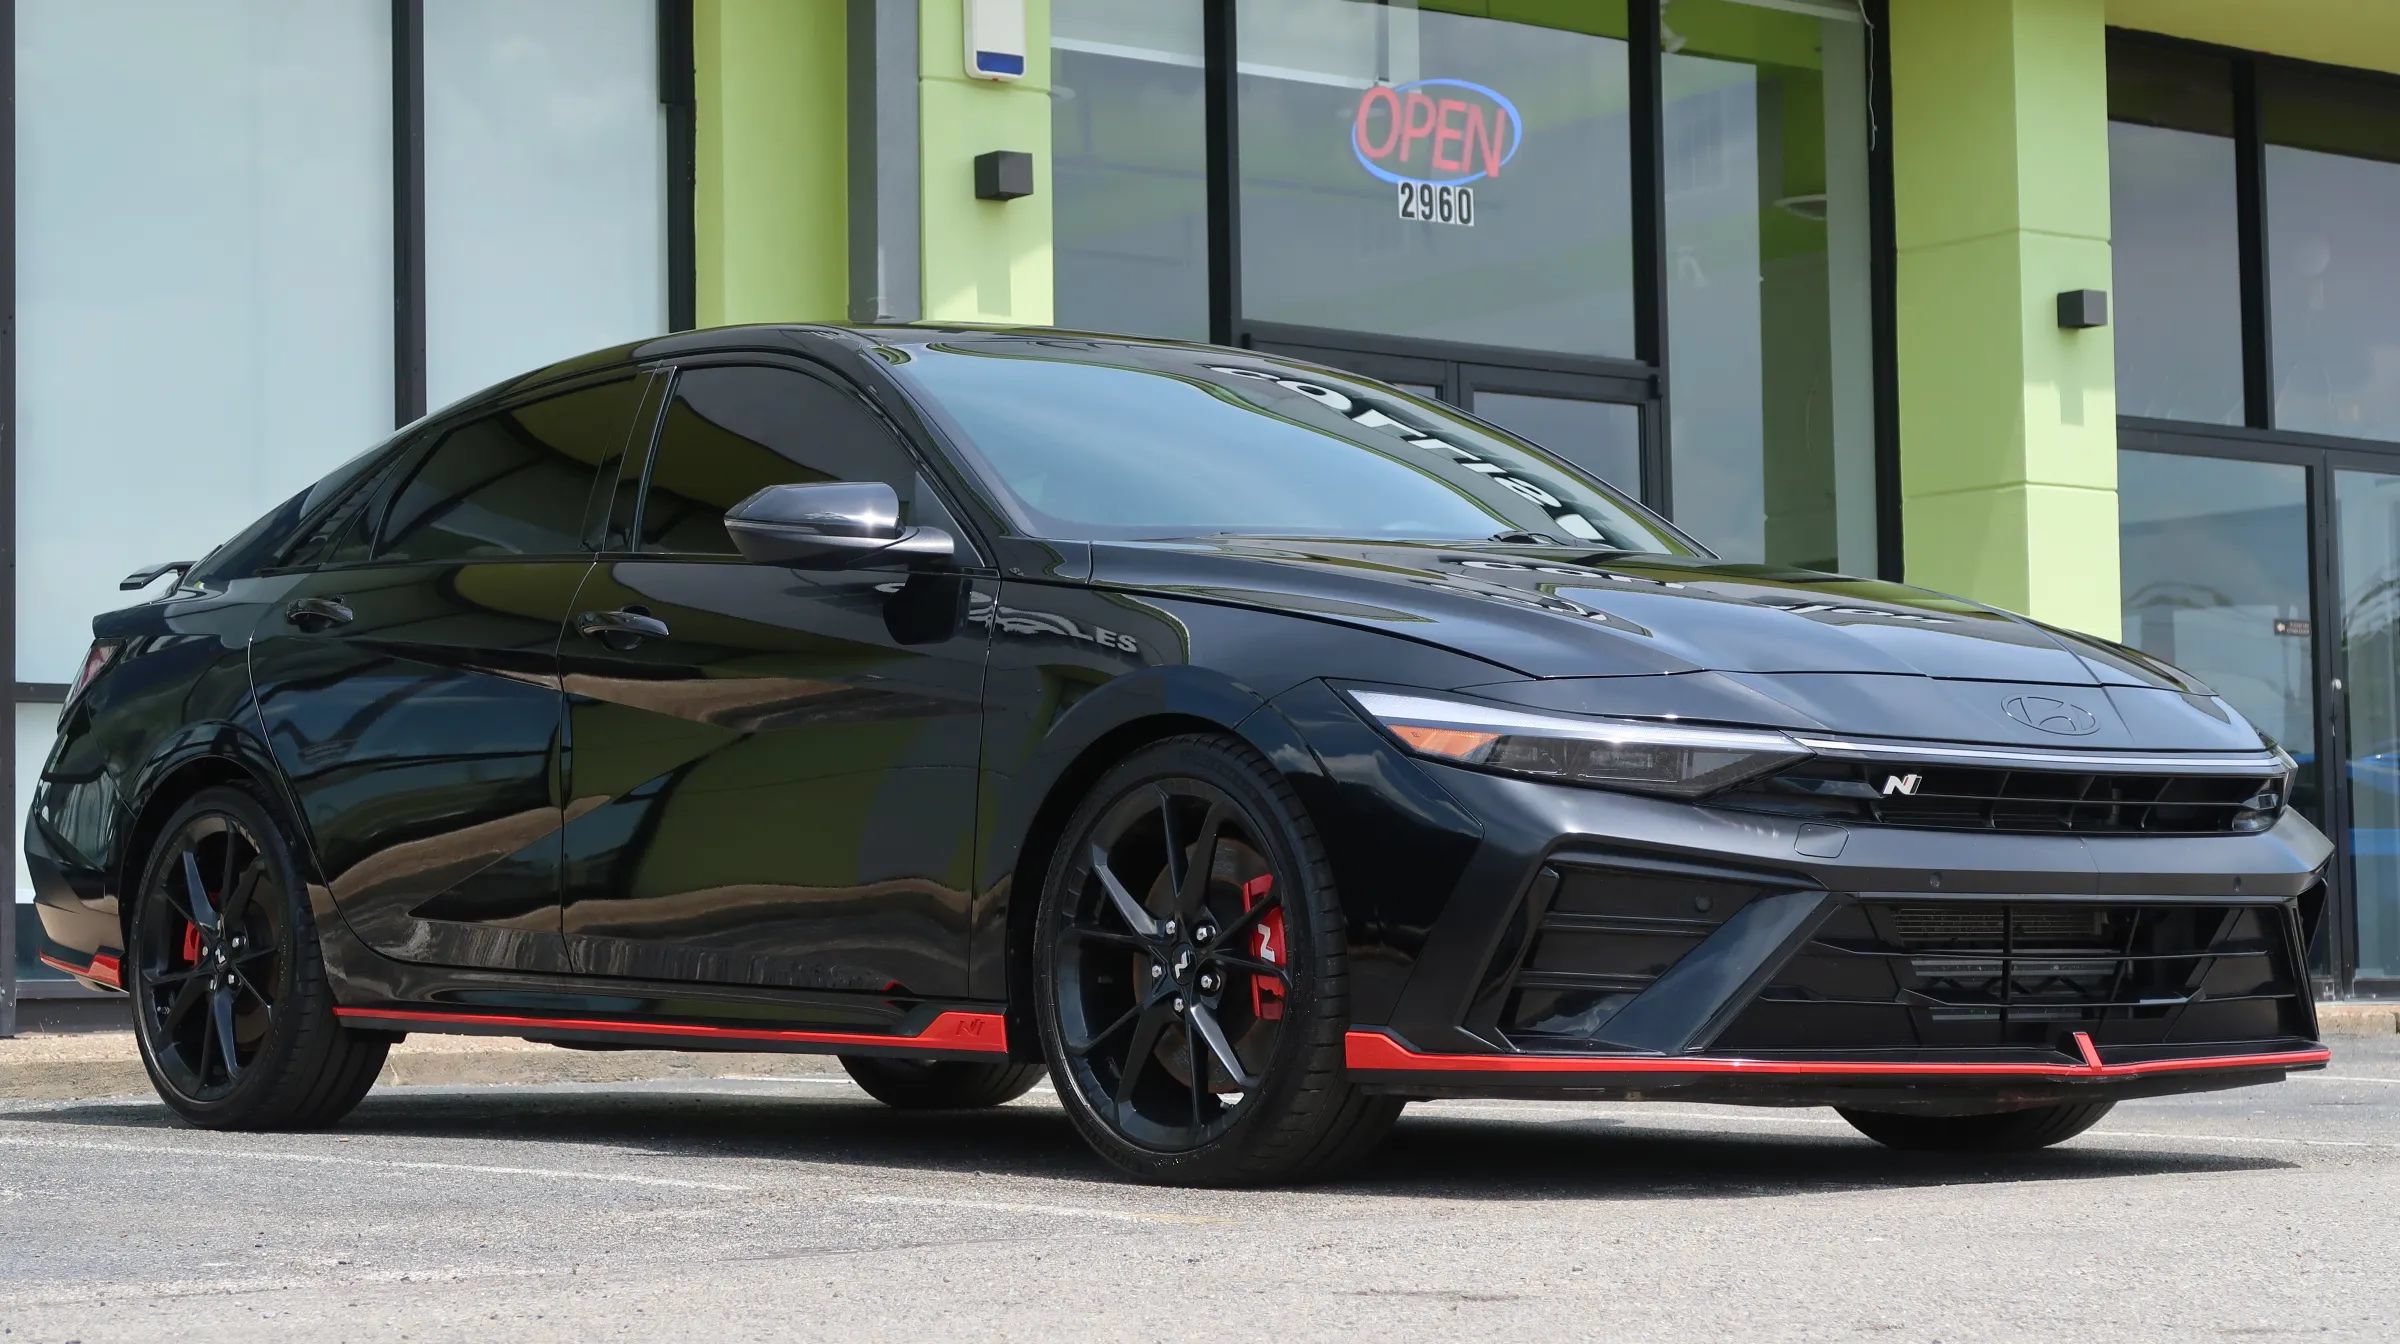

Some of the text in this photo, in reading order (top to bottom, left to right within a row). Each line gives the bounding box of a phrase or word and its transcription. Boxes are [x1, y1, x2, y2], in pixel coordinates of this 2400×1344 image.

[1356, 86, 1507, 178] OPEN
[1400, 182, 1472, 225] 2960
[1883, 774, 1922, 796] N
